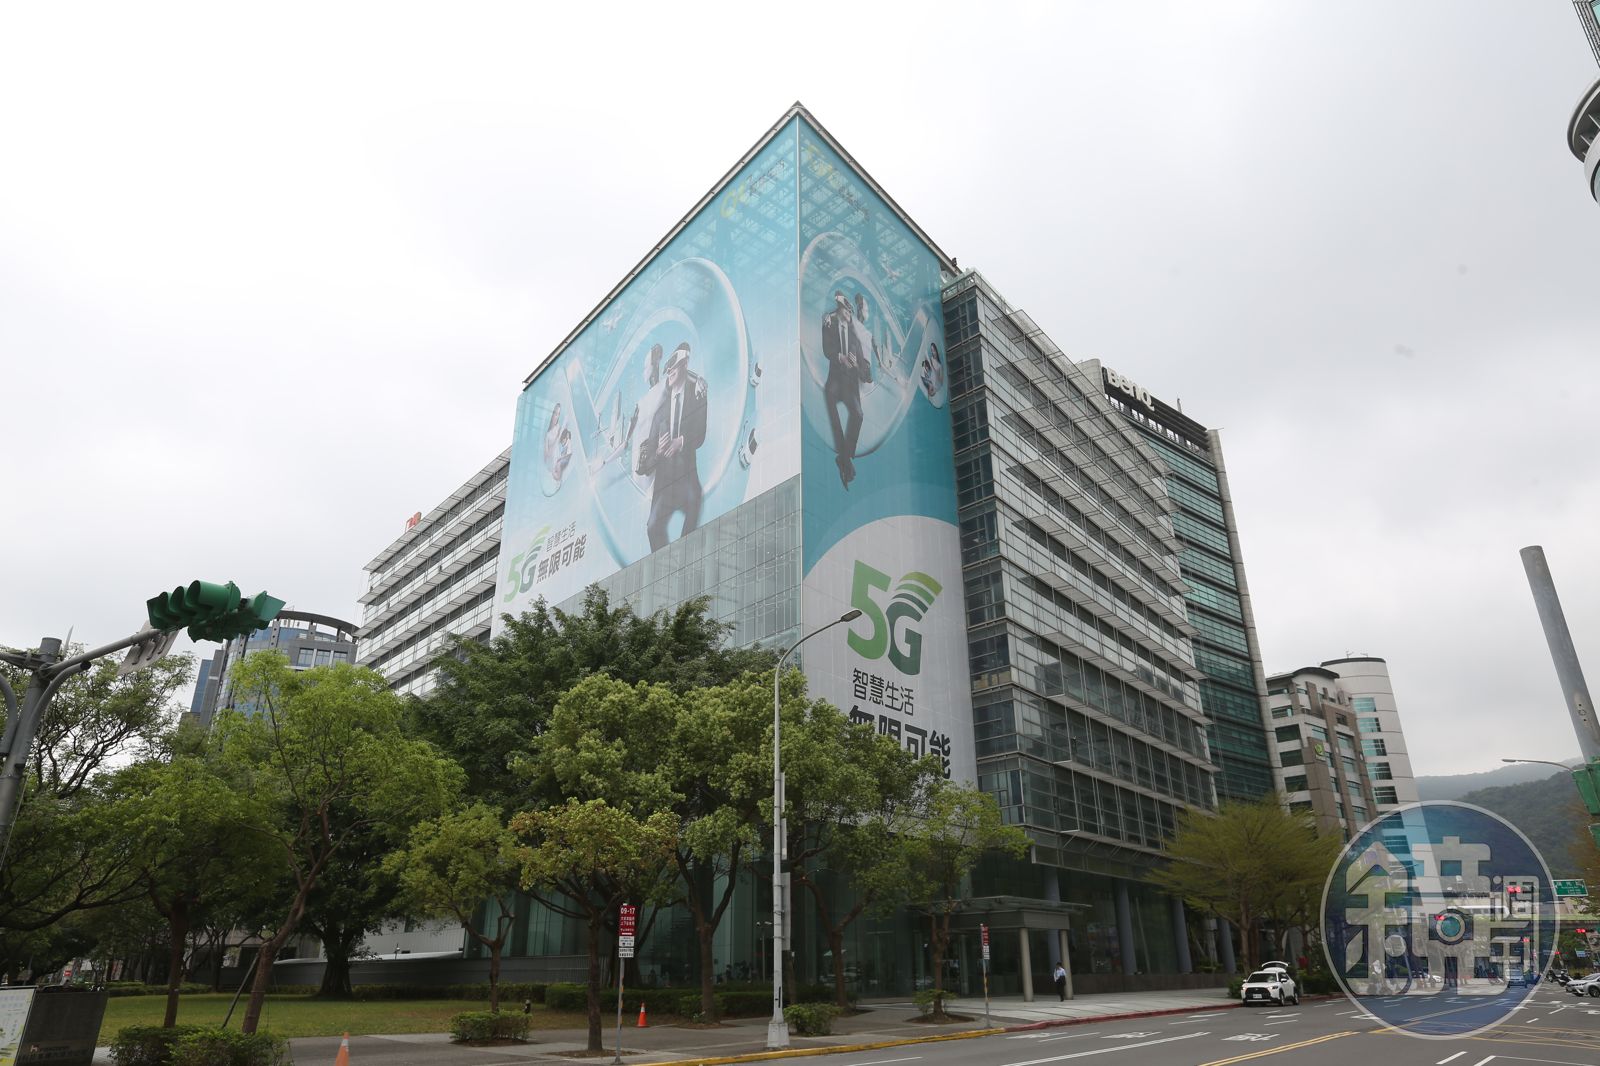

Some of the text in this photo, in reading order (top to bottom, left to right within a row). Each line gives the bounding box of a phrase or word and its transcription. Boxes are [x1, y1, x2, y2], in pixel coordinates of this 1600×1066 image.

[1107, 366, 1155, 412] BenQ
[504, 540, 545, 603] 5G
[537, 533, 588, 584] 無限可能
[847, 560, 932, 676] 5G
[852, 667, 915, 717] 智慧生活
